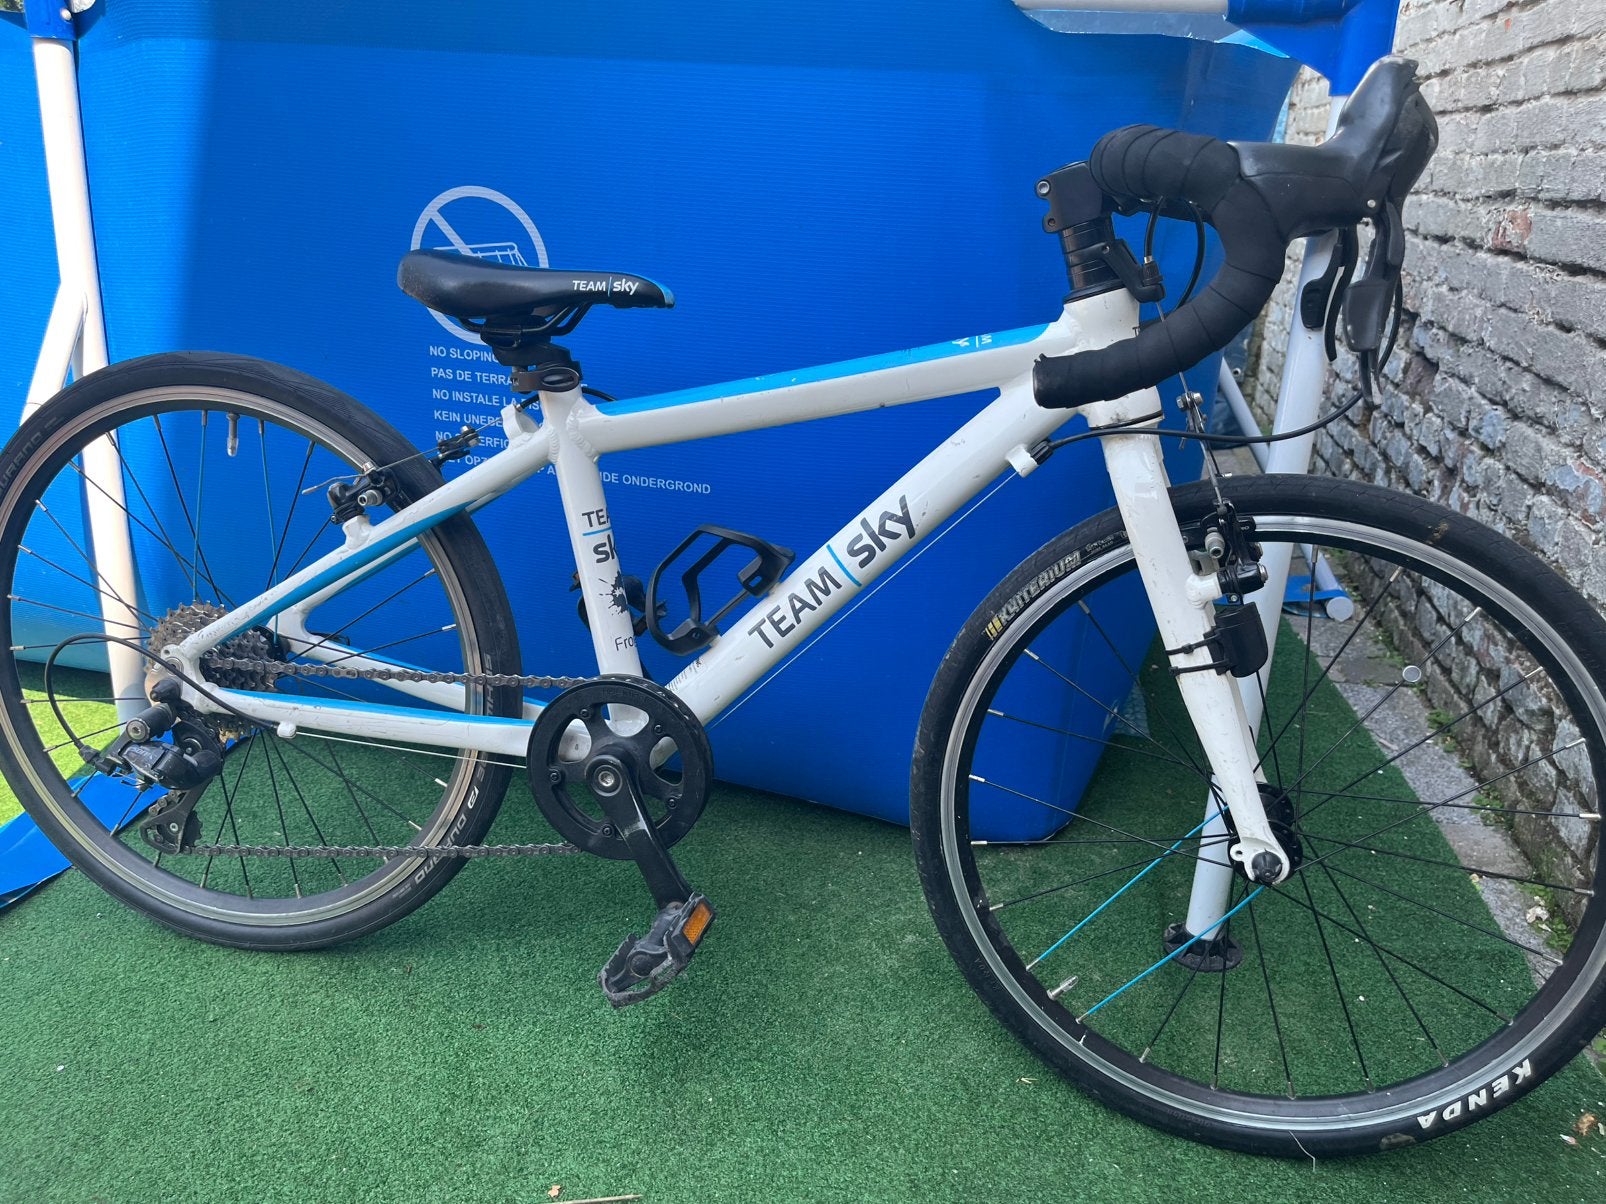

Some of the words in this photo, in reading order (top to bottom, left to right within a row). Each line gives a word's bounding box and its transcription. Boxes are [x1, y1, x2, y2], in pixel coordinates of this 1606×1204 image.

[572, 280, 606, 292] TEAM
[612, 278, 639, 296] sky
[429, 345, 446, 357] NO
[430, 367, 453, 379] PAS
[456, 370, 472, 382] DE
[475, 372, 514, 386] TERRA
[432, 388, 449, 400] NO
[452, 391, 500, 406] INSTALE
[434, 410, 460, 423] KEIN
[463, 413, 503, 428] UNEBE
[0, 431, 42, 492] URANO
[622, 474, 711, 494] ONDERGROND
[747, 565, 843, 649] TEAM
[846, 494, 917, 570] sky
[615, 636, 637, 651] Fro
[1416, 1058, 1532, 1129] KENDA
